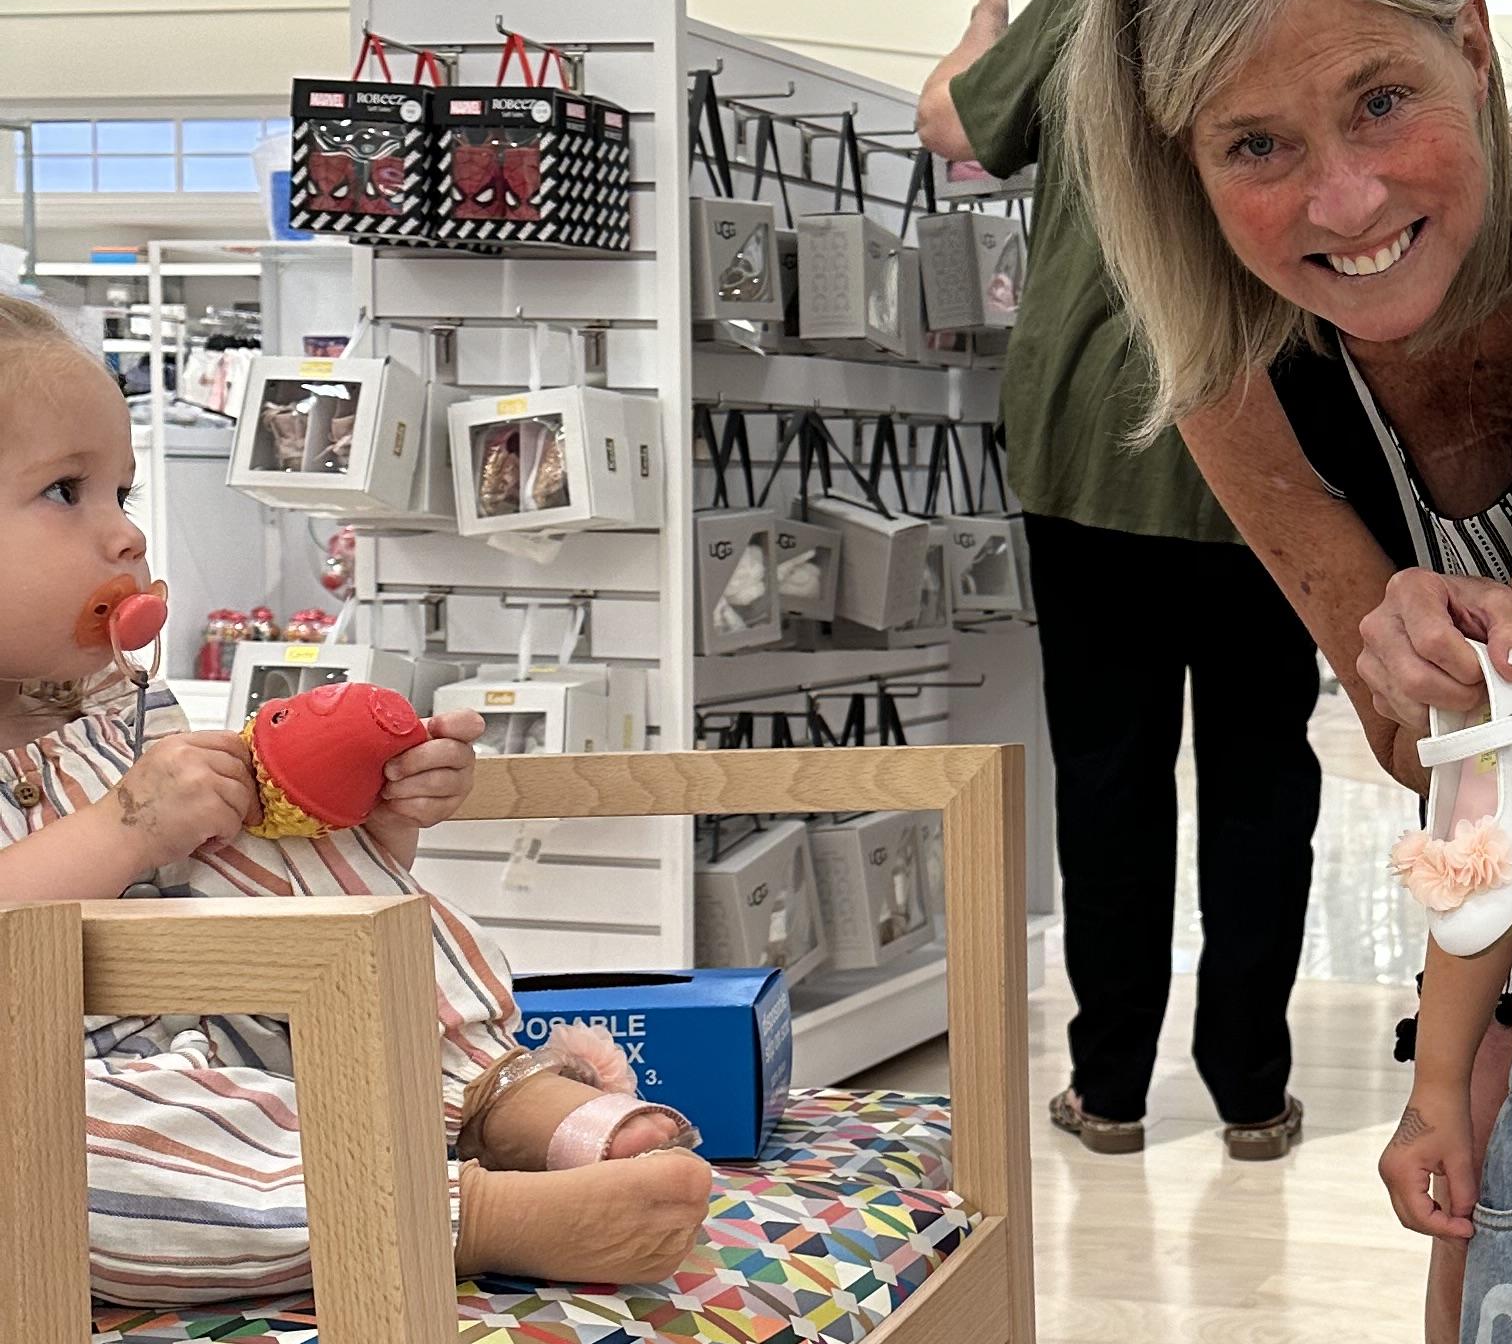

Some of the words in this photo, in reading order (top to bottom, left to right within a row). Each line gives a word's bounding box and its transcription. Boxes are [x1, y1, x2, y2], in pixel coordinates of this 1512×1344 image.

[714, 220, 736, 240] UGG
[953, 532, 976, 549] UGG
[709, 540, 733, 560] UGG
[644, 1069, 663, 1085] 3.
